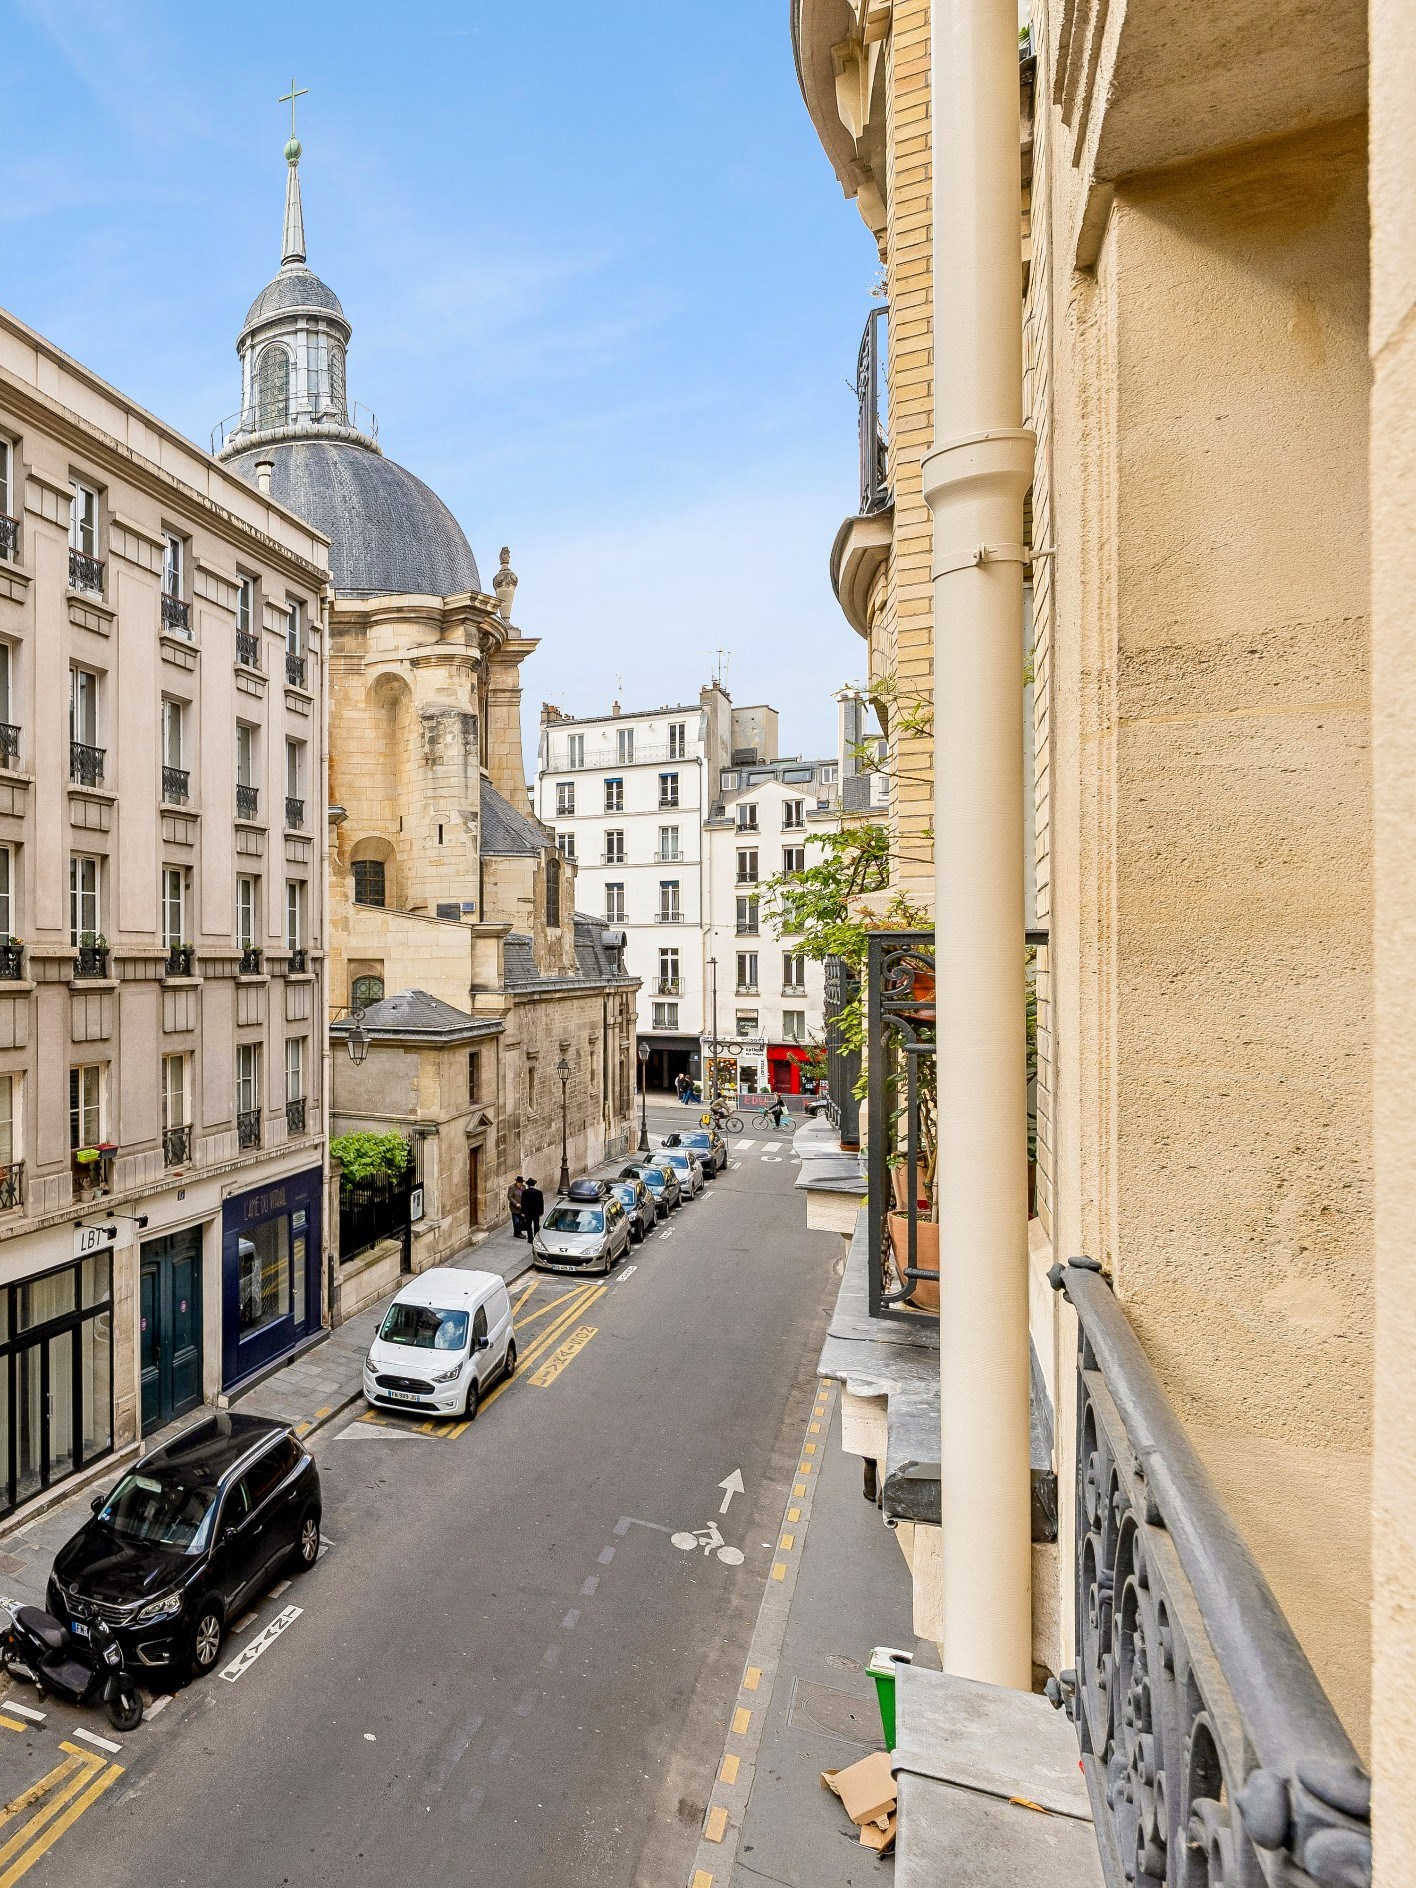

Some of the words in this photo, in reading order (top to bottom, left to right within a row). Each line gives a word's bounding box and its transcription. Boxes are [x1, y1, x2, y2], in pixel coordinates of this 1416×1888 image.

[80, 1229, 102, 1252] LBT
[537, 1326, 596, 1386] LIVRAISON
[224, 1607, 297, 1680] PAYANT
